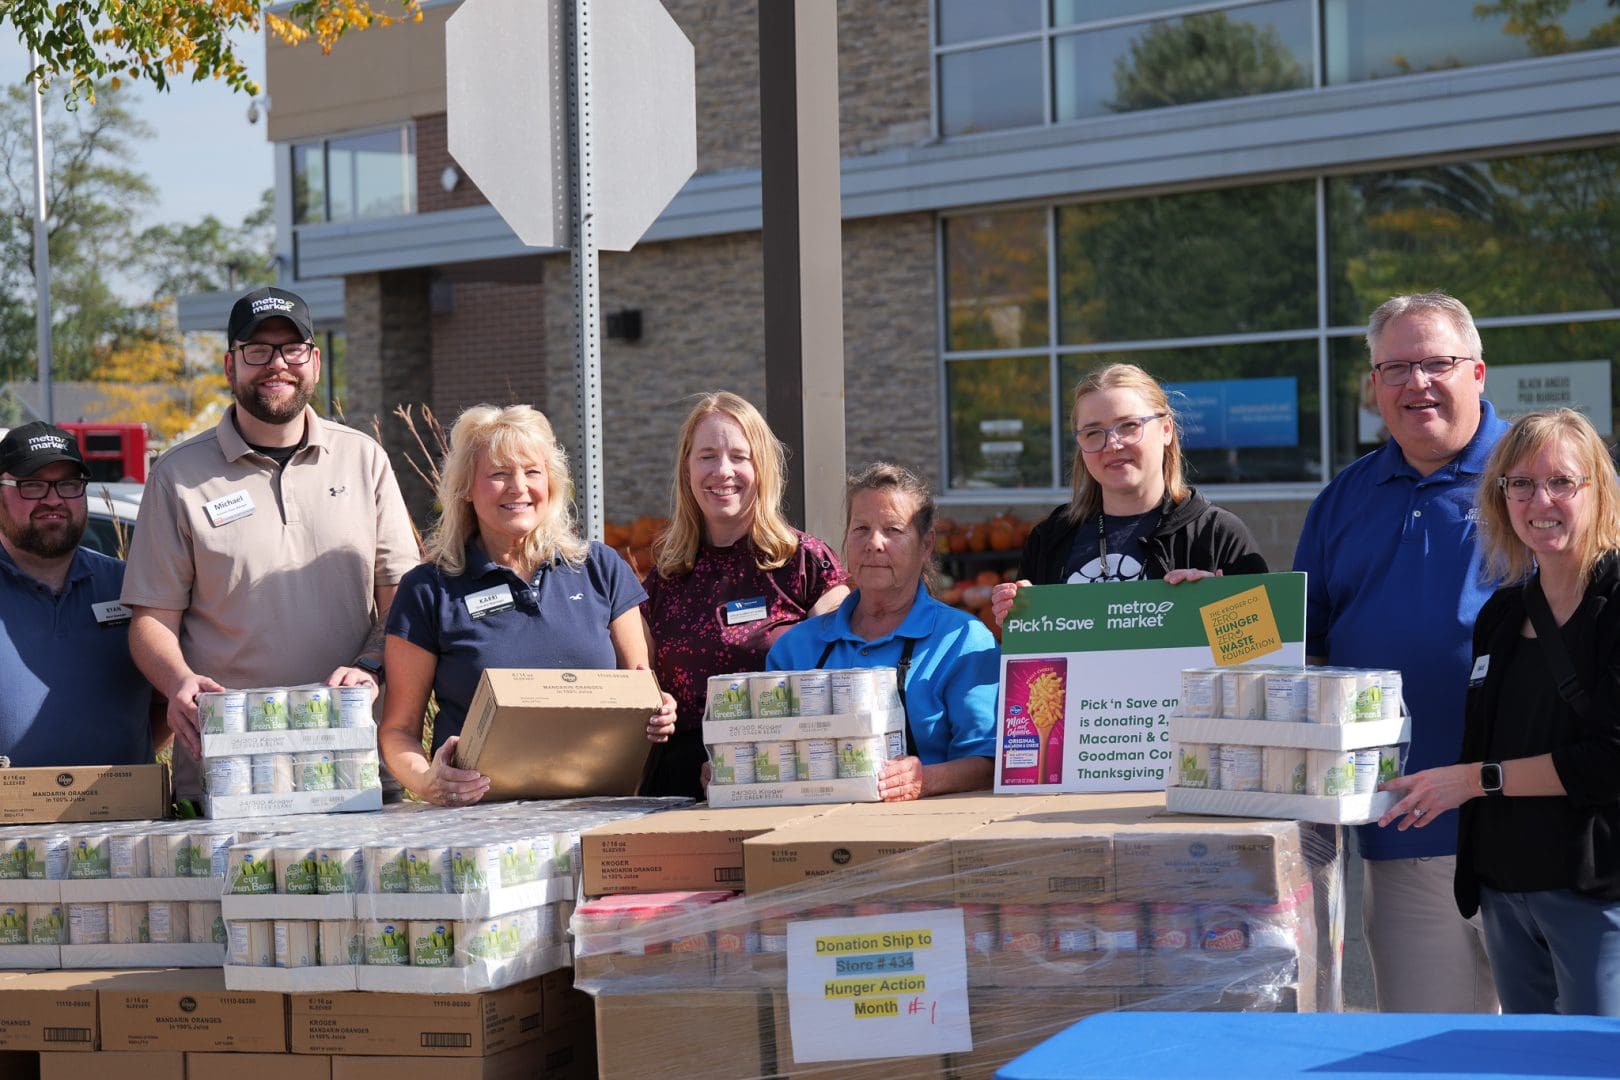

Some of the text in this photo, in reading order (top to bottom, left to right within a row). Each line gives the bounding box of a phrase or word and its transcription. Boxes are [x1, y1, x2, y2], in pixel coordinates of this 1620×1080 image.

[252, 297, 284, 308] metro
[252, 304, 292, 314] market
[28, 434, 63, 445] metro
[30, 441, 69, 452] market
[214, 496, 244, 510] Michael
[1108, 600, 1156, 614] metro
[1209, 610, 1220, 618] THE
[1221, 600, 1246, 613] KROGER
[1056, 618, 1094, 630] Save
[1107, 614, 1164, 630] market
[1212, 611, 1238, 627] ZERO
[1214, 613, 1259, 636] HUNGER
[1217, 629, 1244, 646] ZERO
[1220, 635, 1254, 654] WASTE
[1222, 638, 1275, 661] FOUNDATION
[1080, 699, 1108, 710] Pick
[1126, 698, 1158, 708] Save
[714, 710, 736, 718] Green
[760, 708, 782, 716] Green
[1080, 716, 1090, 728] is
[1094, 715, 1154, 728] donating
[758, 724, 782, 733] Kroger
[1080, 732, 1142, 744] Macaroni
[1146, 732, 1156, 742] &
[1078, 750, 1144, 762] Goodman
[1077, 766, 1164, 781] Thanksgiving
[758, 788, 784, 797] Kroger
[288, 882, 314, 892] Green
[816, 934, 932, 952] Donation Ship to
[368, 955, 390, 964] Green
[417, 956, 441, 965] Green
[836, 956, 914, 972] Store # 434
[824, 978, 926, 997] Hunger Action
[854, 1001, 898, 1015] Month
